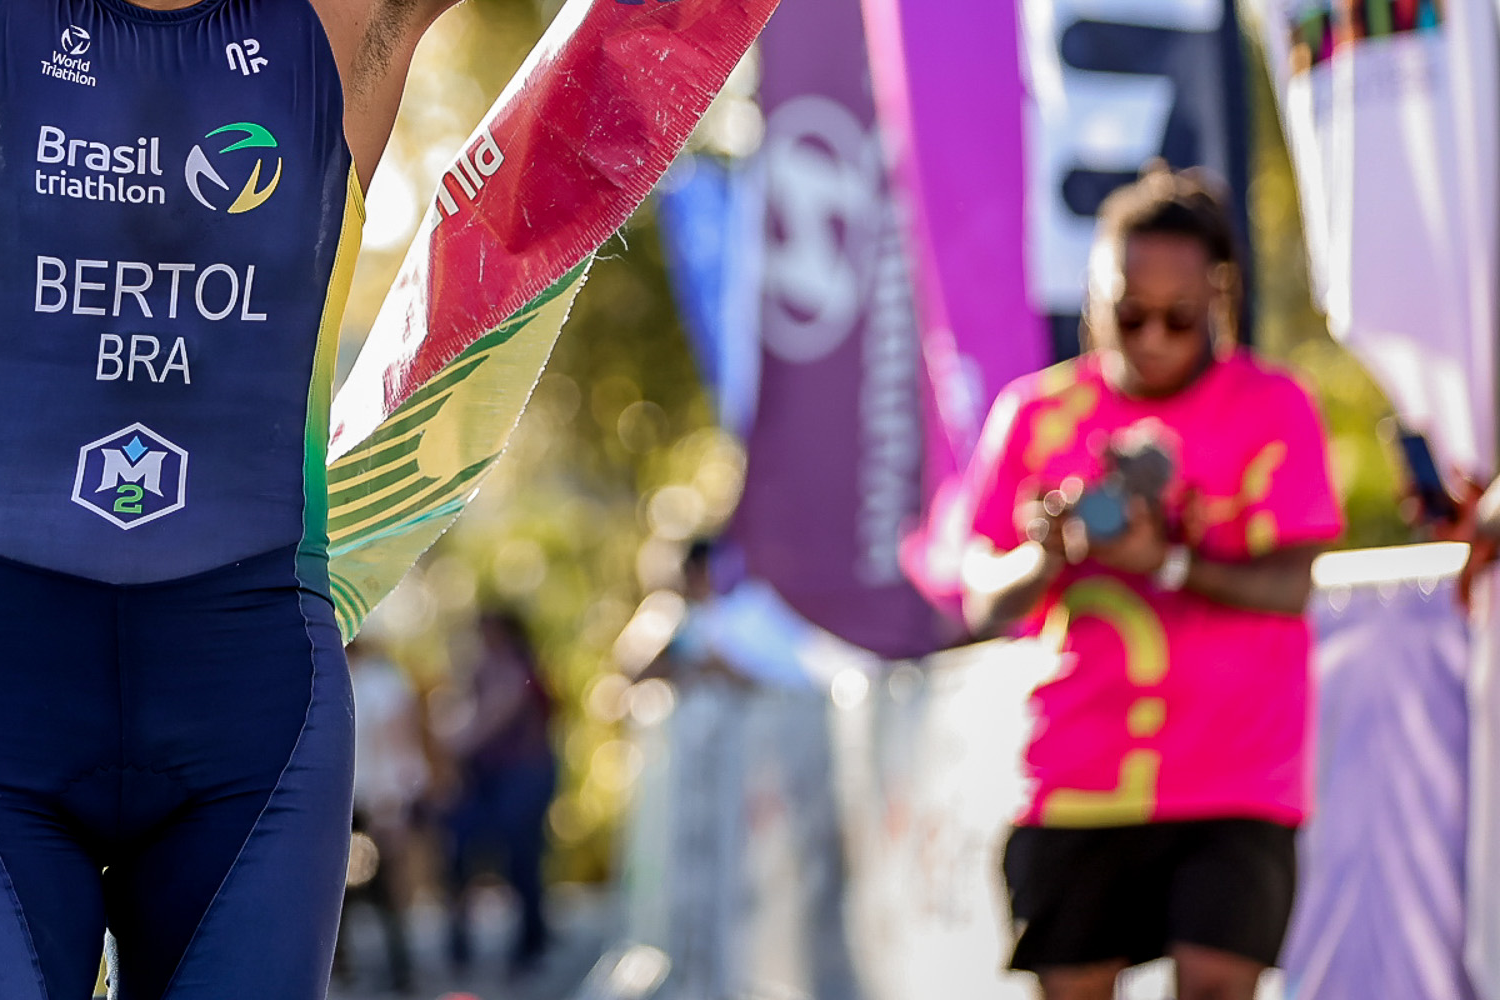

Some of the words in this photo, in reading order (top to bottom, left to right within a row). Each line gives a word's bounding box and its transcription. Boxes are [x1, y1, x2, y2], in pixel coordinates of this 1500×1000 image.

[41, 60, 97, 87] Triathlon
[52, 50, 91, 73] World
[36, 125, 164, 176] Brasil
[35, 169, 166, 205] triathlon
[34, 254, 268, 322] BERTOL
[95, 333, 191, 385] BRA
